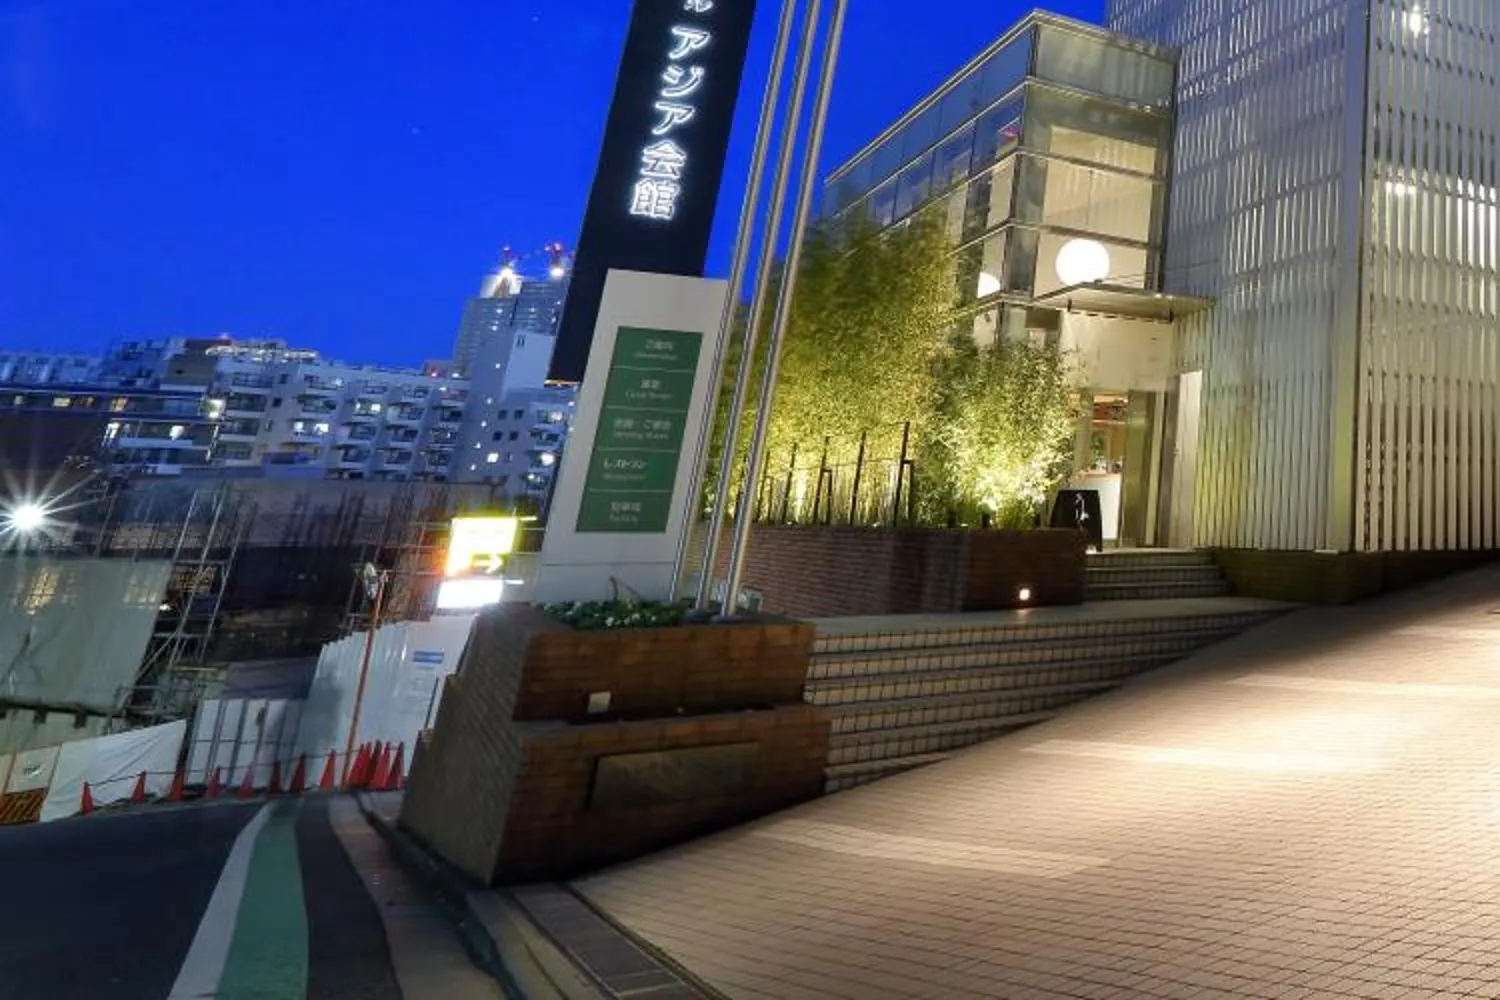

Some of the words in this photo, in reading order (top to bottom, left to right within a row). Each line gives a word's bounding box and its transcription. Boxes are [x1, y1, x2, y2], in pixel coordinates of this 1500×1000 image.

[630, 25, 711, 220] アジア会館
